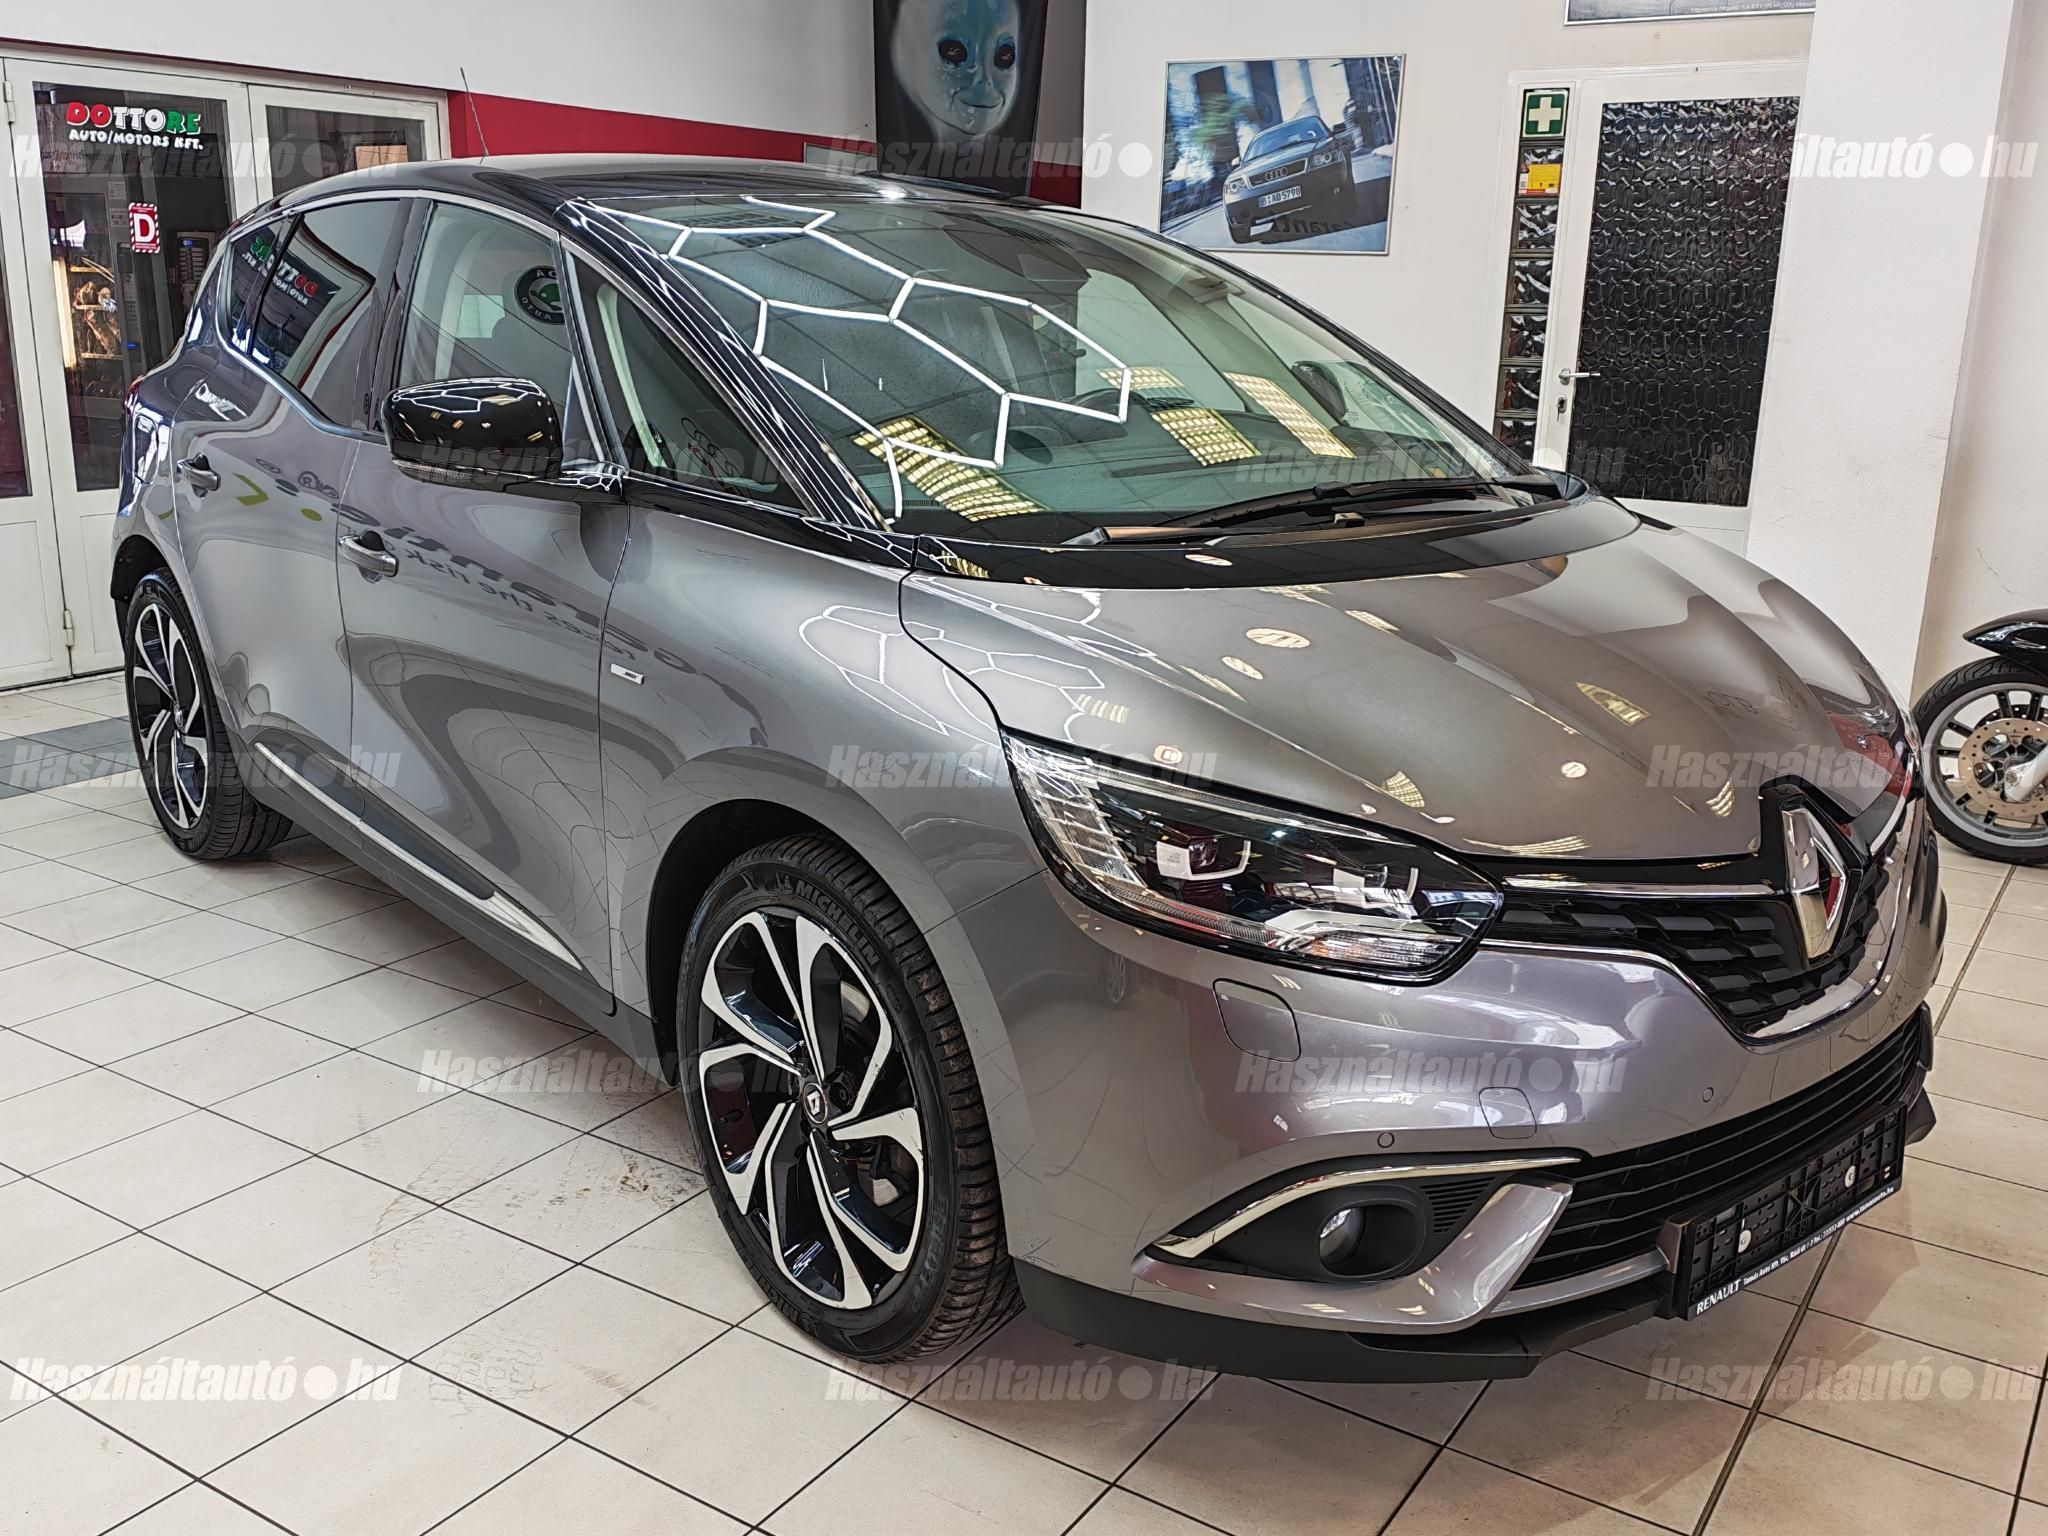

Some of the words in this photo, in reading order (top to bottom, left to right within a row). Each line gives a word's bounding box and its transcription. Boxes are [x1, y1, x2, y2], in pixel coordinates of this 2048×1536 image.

[66, 101, 202, 136] DOTTORE
[69, 128, 170, 148] AUTO/MOTORS
[174, 136, 204, 150] KFT.
[133, 213, 156, 243] D
[795, 879, 881, 968] MICHELIN
[1696, 1279, 1741, 1316] RENAULT
